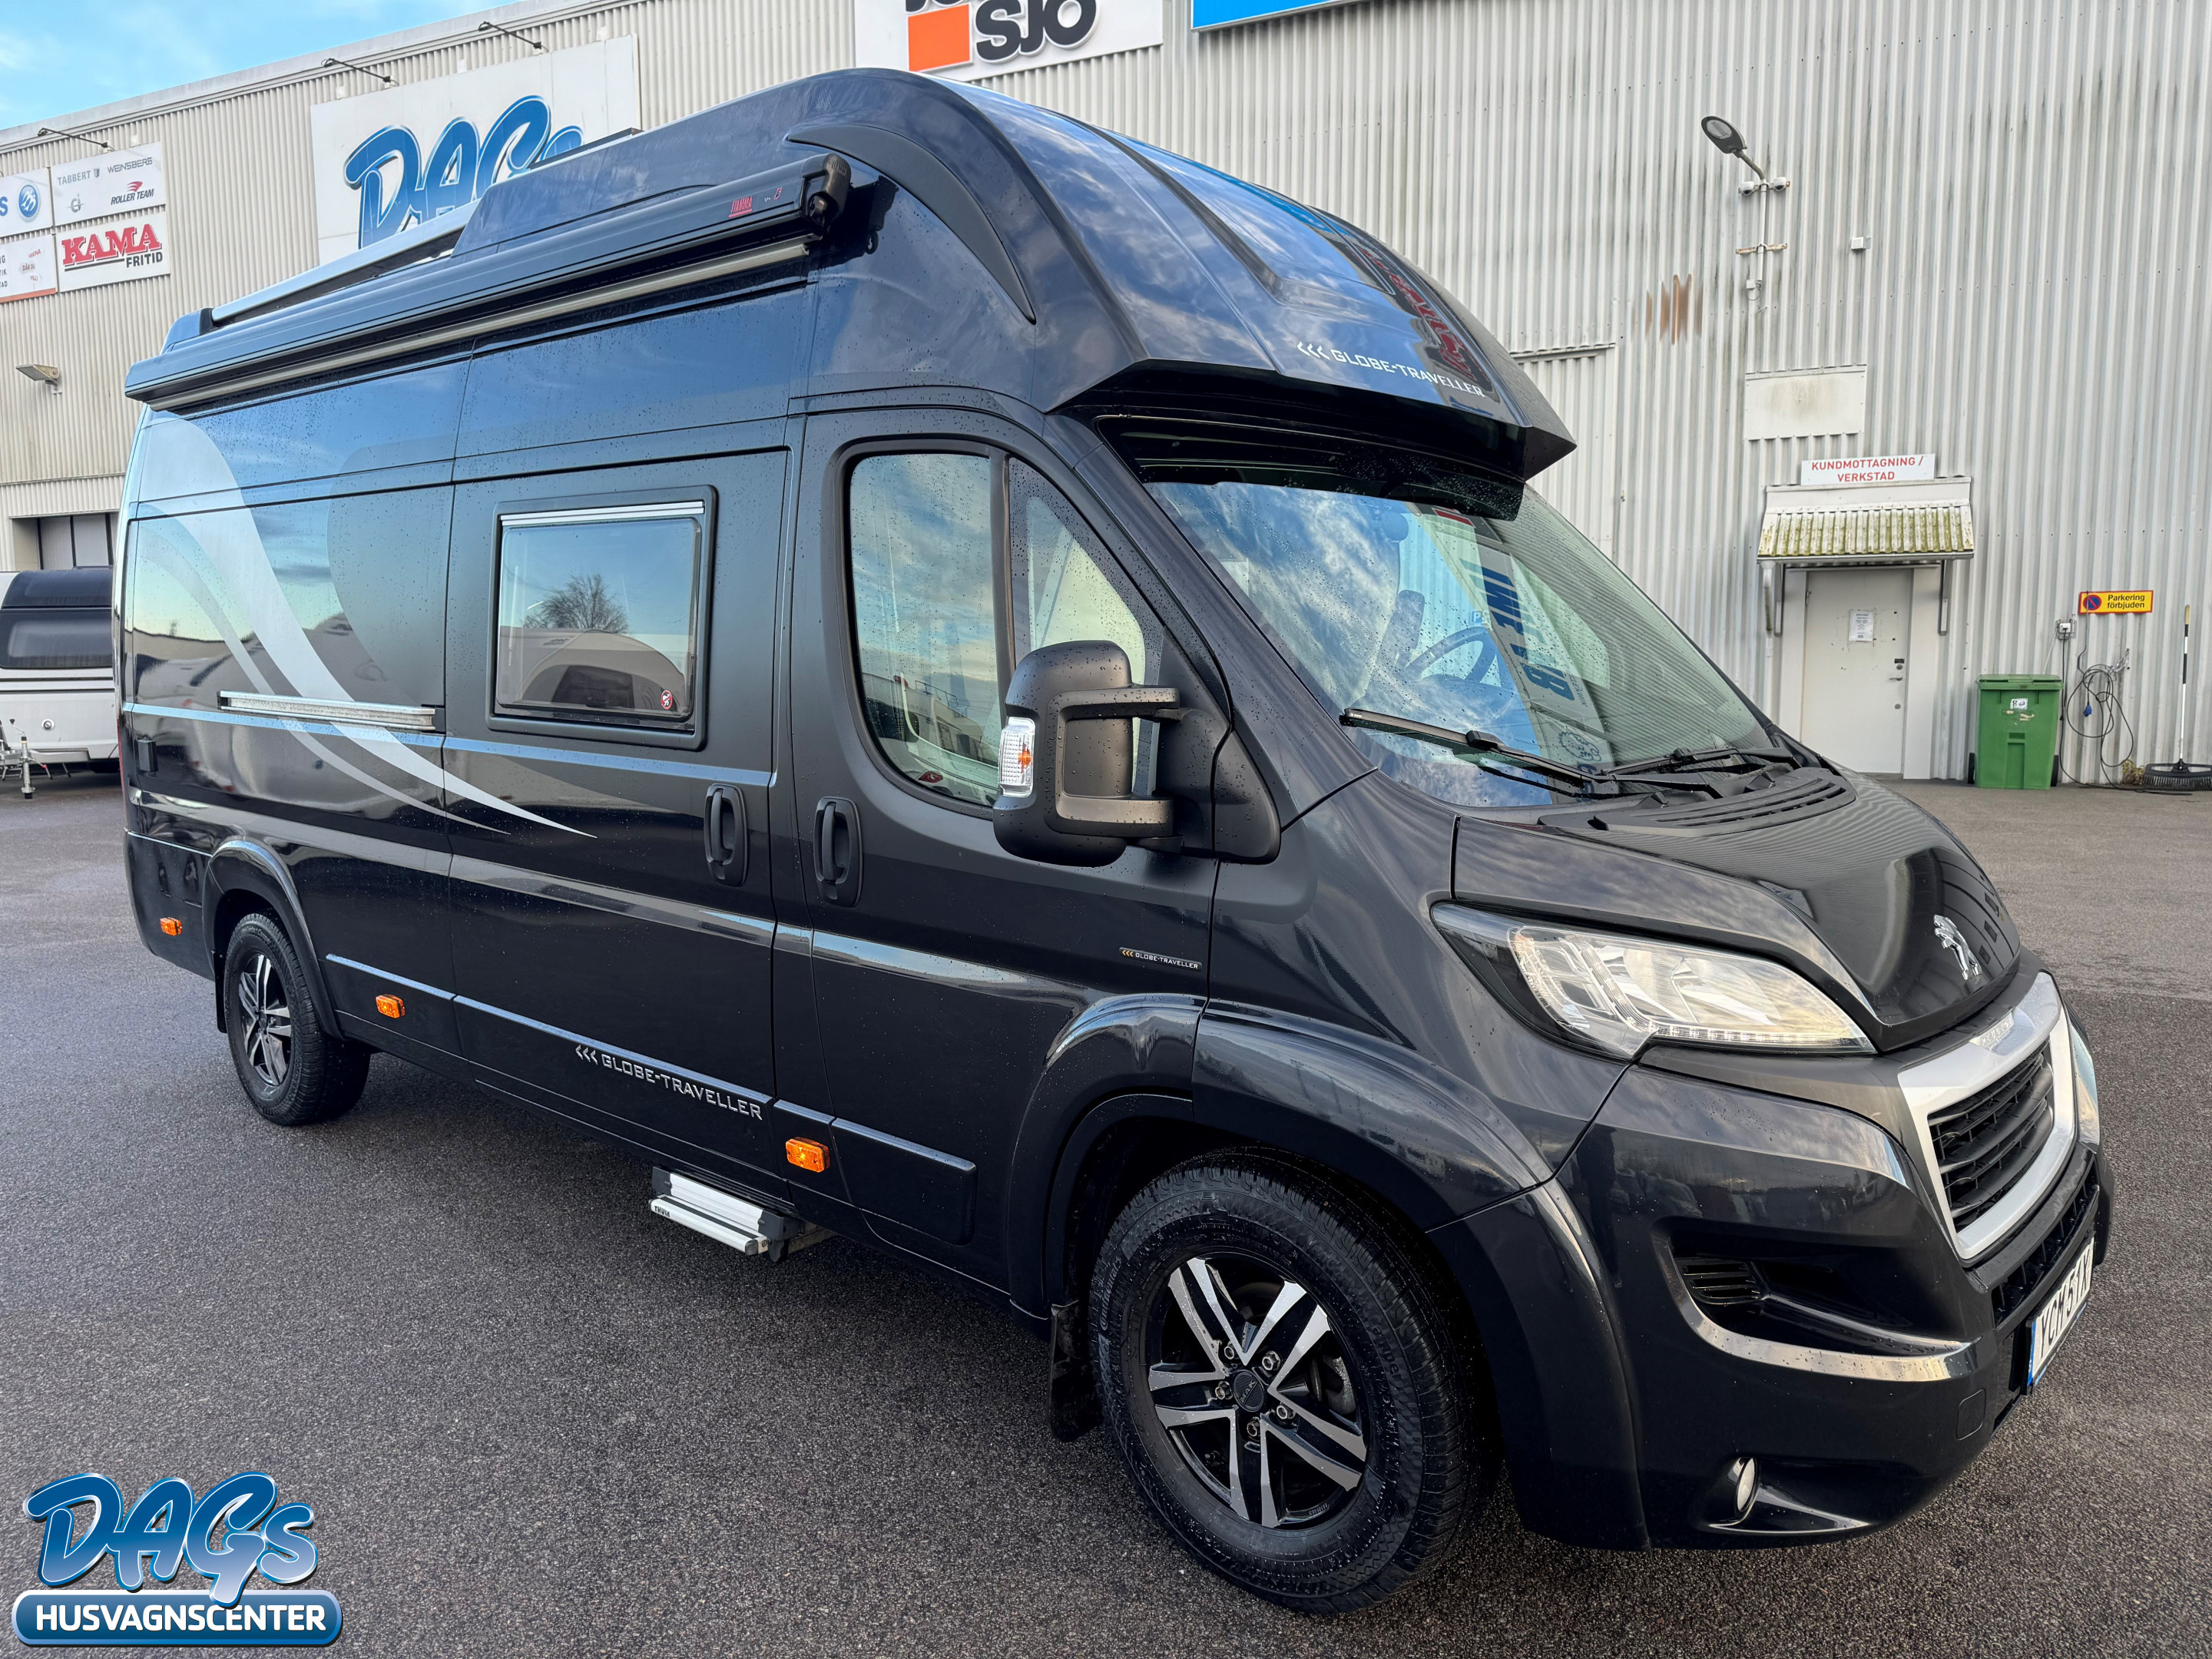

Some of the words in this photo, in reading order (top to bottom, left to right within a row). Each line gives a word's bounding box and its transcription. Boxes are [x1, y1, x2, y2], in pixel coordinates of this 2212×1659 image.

[107, 157, 153, 174] WEINSBERG
[58, 170, 91, 186] TABBERT
[111, 192, 136, 205] ROLLER
[137, 188, 154, 200] TEAM
[61, 224, 162, 266] KAMA
[126, 251, 163, 268] FRITID
[1330, 349, 1486, 398] GLOBE-TRAVELLER
[1811, 456, 1916, 471] KUNDMOTTAGNING
[1837, 471, 1895, 482] VERKSTAD
[1135, 952, 1198, 969] GLOBE-TRAVELLER
[601, 1053, 763, 1121] GLOBE-TRAVELLER
[654, 1206, 671, 1217] THULE
